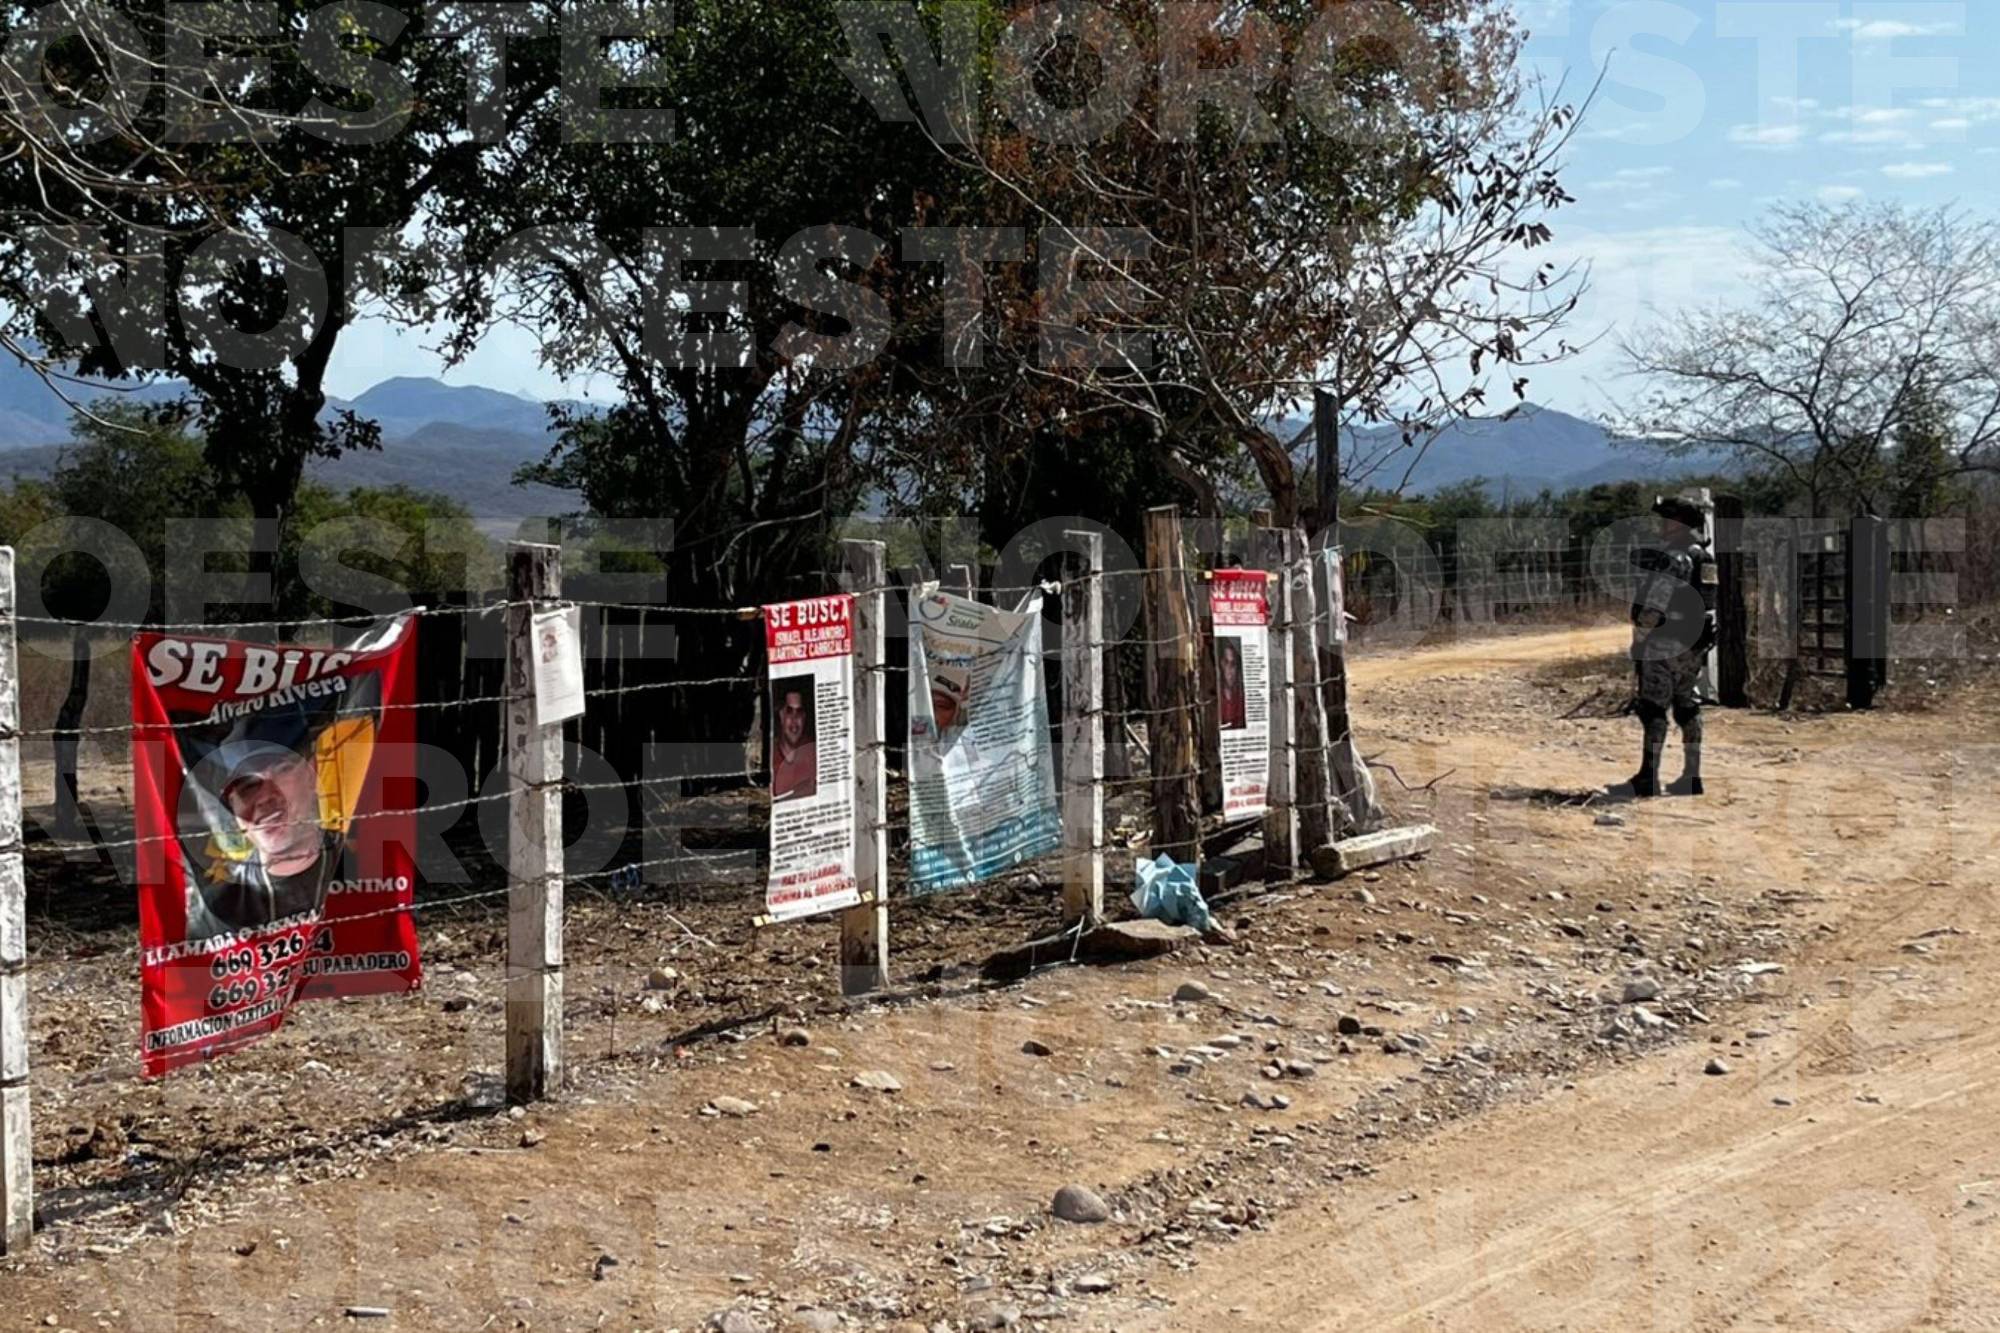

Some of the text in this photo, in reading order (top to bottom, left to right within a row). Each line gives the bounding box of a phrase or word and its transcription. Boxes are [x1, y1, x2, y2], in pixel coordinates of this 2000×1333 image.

[770, 597, 850, 629] SE BUSCA
[148, 639, 227, 693] SE
[146, 931, 237, 966] LLAMADA
[210, 949, 253, 979] 669
[257, 930, 305, 968] 326
[323, 952, 409, 975] PARADERO
[208, 975, 259, 1010] 669
[145, 1013, 233, 1051] INFORMACION
